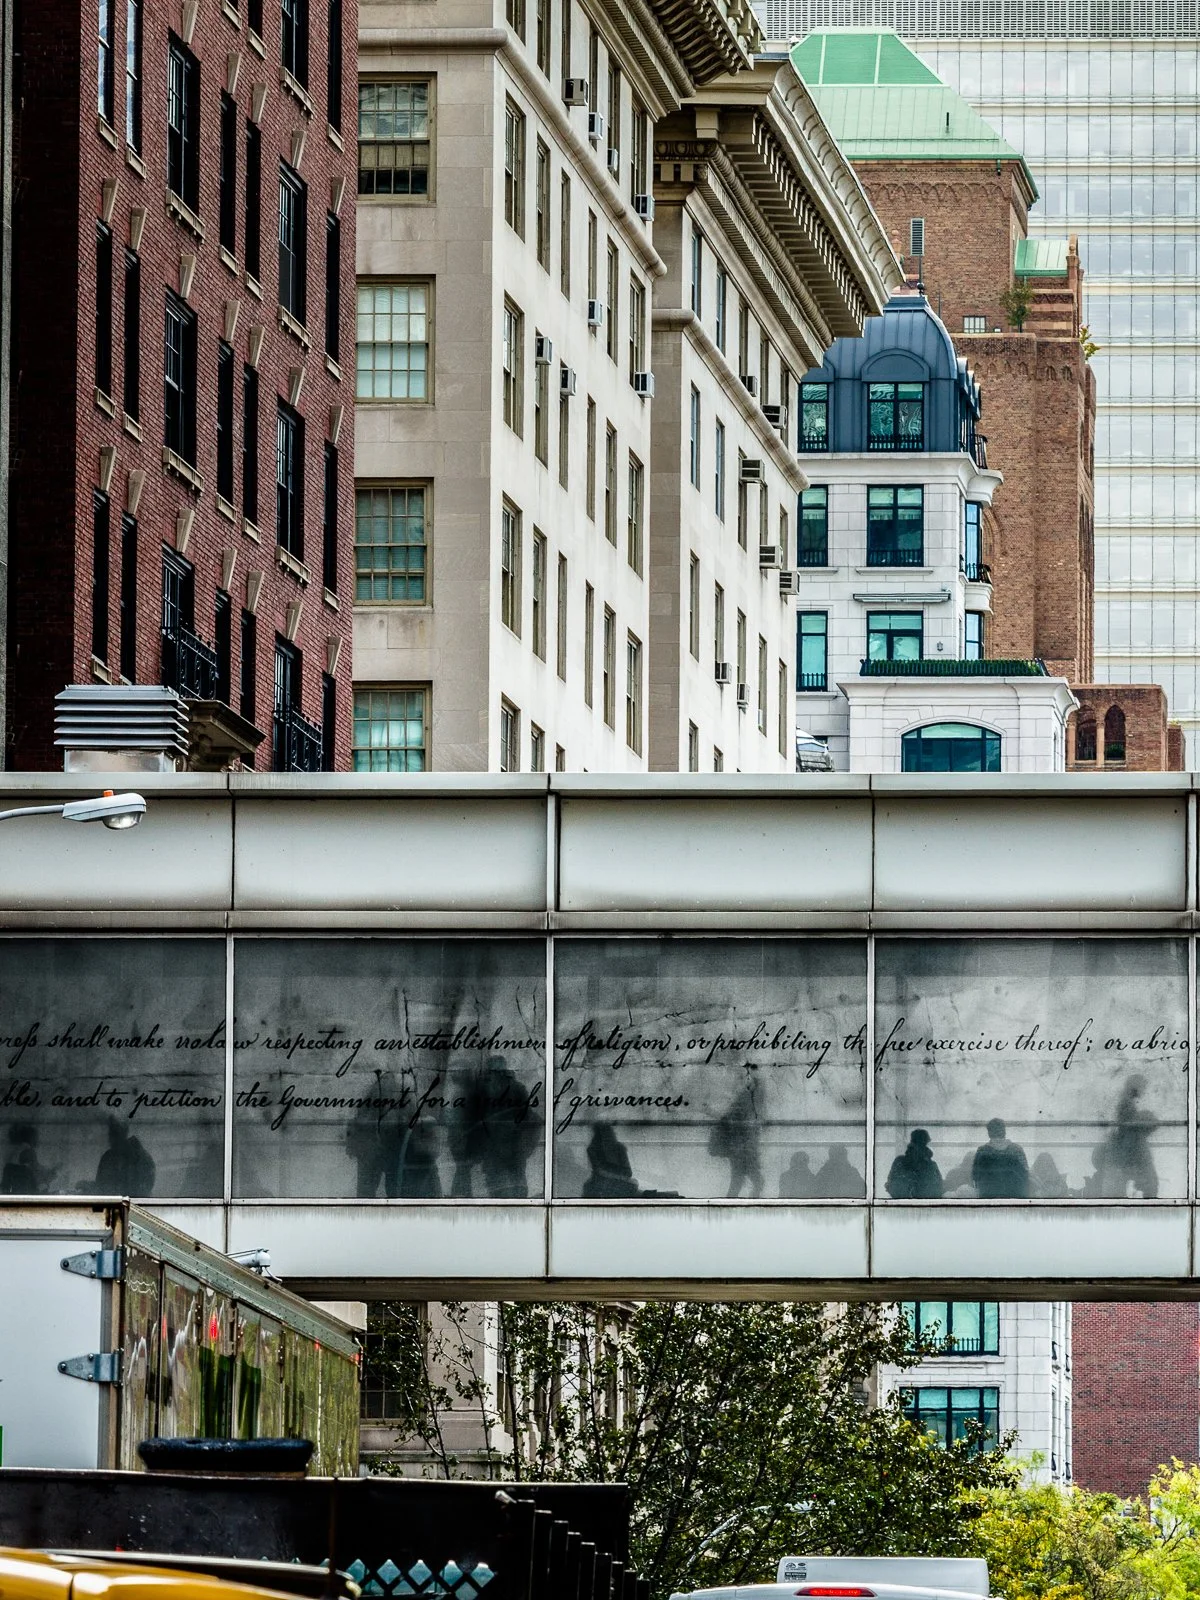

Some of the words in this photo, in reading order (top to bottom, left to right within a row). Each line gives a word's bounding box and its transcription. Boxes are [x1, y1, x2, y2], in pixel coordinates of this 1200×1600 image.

[45, 1022, 109, 1048] shall
[108, 1023, 163, 1048] make
[265, 1025, 362, 1077] respecting
[412, 1025, 548, 1050] establishmen
[687, 1038, 712, 1050] or
[706, 1021, 832, 1078] prohibiting
[874, 1017, 923, 1072] free
[926, 1032, 1008, 1050] exercise
[1104, 1038, 1129, 1050] or
[52, 1081, 102, 1107] and
[104, 1088, 127, 1107] to
[128, 1089, 222, 1118] petition
[236, 1081, 273, 1107] the
